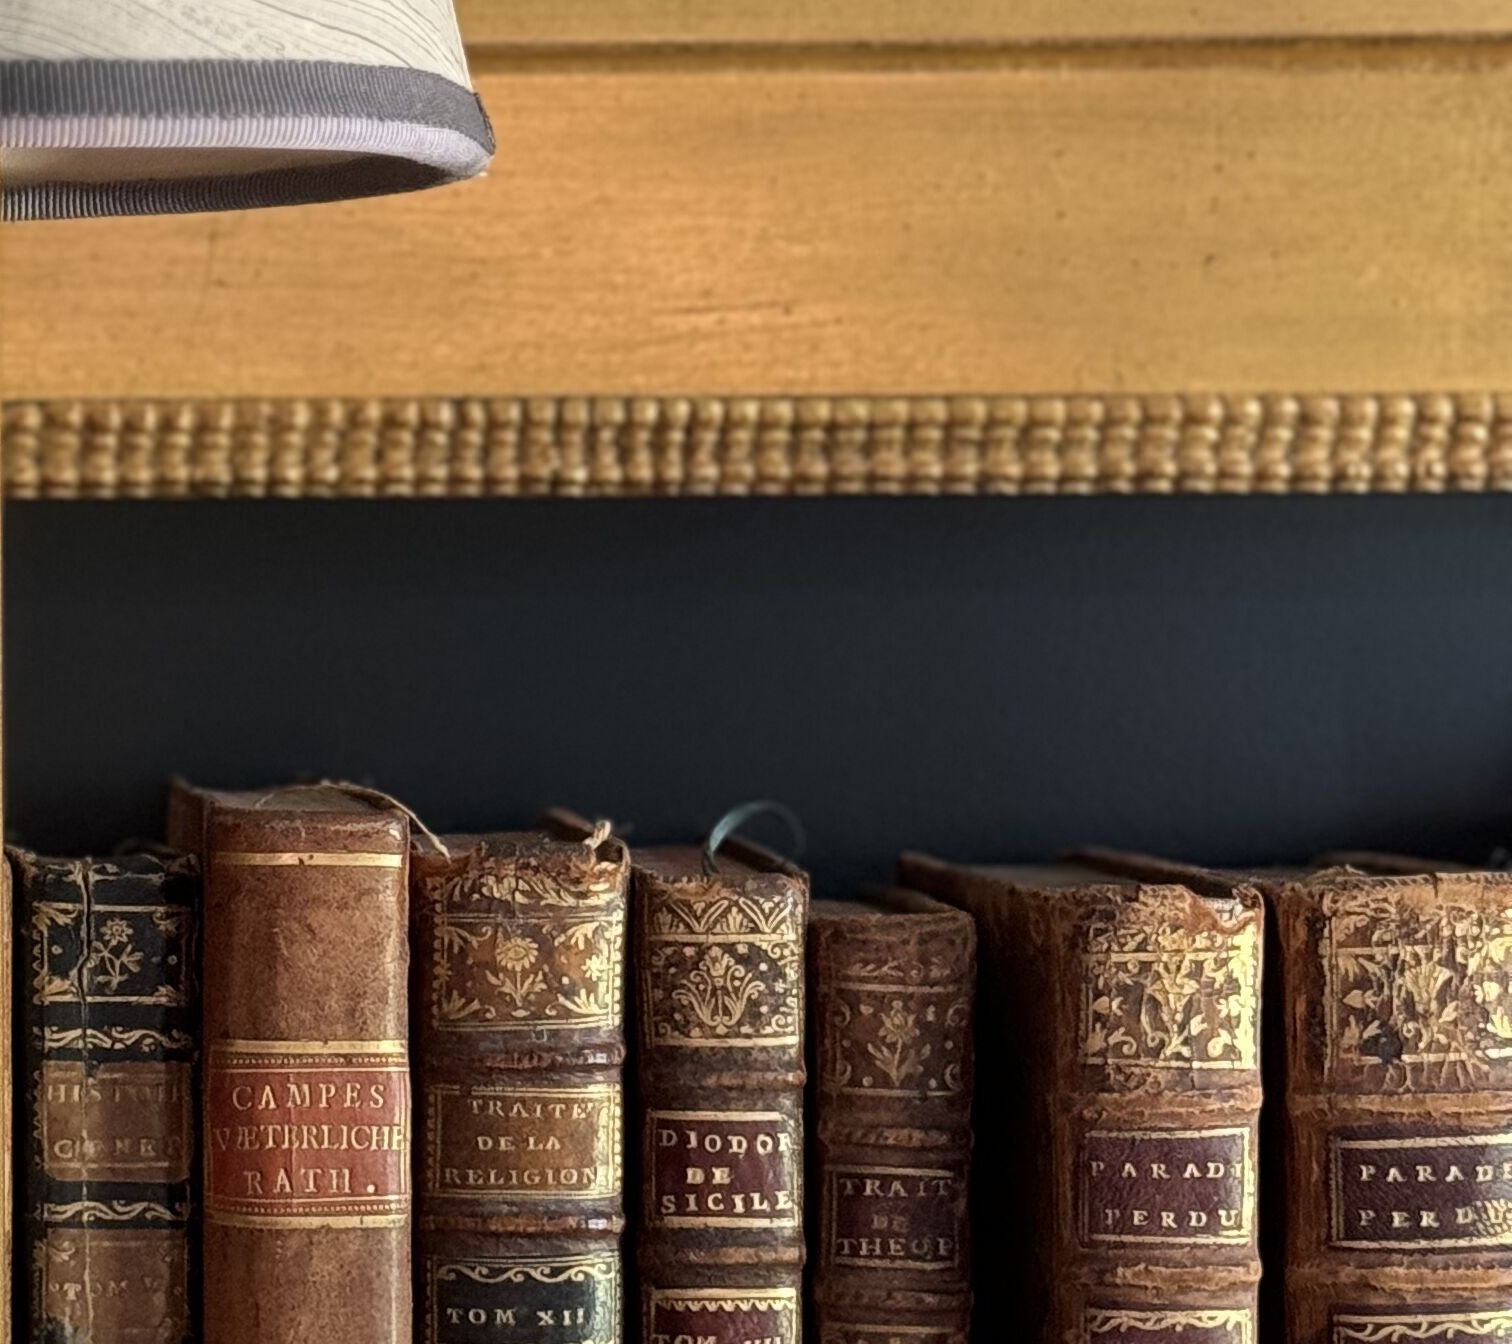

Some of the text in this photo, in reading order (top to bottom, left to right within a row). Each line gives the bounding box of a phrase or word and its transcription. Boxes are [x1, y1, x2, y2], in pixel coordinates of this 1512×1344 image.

[231, 1082, 386, 1110] CAMPES
[476, 1135, 562, 1151] DE LA
[444, 1167, 598, 1188] RELIGION
[685, 1166, 733, 1185] DE
[660, 1190, 793, 1215] SICILE
[1104, 1209, 1240, 1228] PERDU
[446, 1307, 518, 1327] TOM
